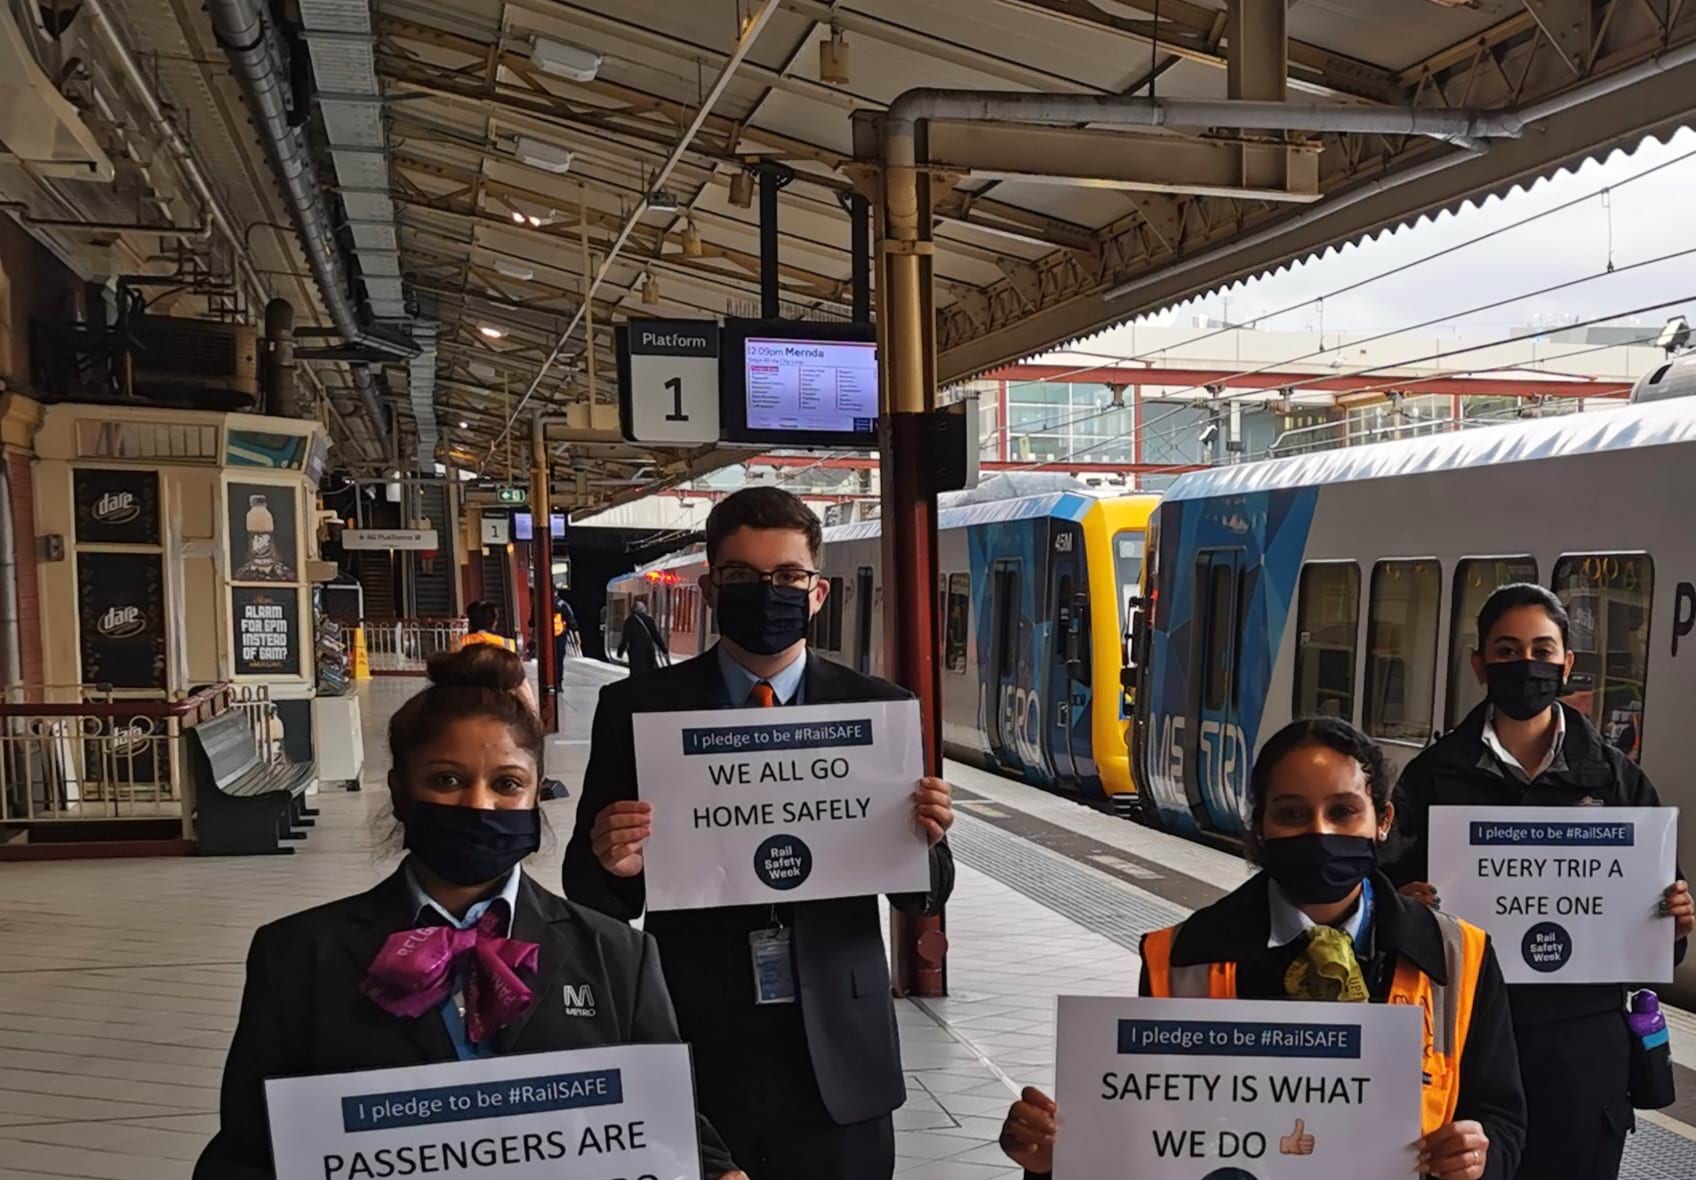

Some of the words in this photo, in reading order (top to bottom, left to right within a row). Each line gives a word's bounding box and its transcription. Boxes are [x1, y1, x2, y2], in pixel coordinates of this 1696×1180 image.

[642, 331, 707, 349] Platform
[785, 347, 824, 358] Mernda
[663, 376, 690, 422] 1
[490, 524, 499, 538] 1
[245, 605, 283, 619] ALARM
[240, 619, 262, 633] FOR
[242, 633, 287, 646] INSTEAD
[242, 647, 257, 660] OF
[693, 733, 698, 747] I
[702, 731, 750, 748] pledge
[754, 731, 769, 744] to
[773, 728, 791, 743] be
[795, 724, 863, 741] #RailSAFE
[708, 763, 751, 786] WE
[760, 760, 804, 783] ALL
[811, 757, 849, 780] GO
[693, 803, 774, 829] HOME
[782, 797, 872, 823] SAFELY
[1486, 826, 1528, 841] pledge
[1531, 828, 1544, 839] to
[1547, 826, 1563, 839] be
[1566, 827, 1626, 840] #RailSAFE
[770, 846, 793, 858] Rail
[764, 856, 802, 870] Safety
[1477, 858, 1547, 879] EVERY
[1553, 858, 1602, 878] TRIP
[1607, 859, 1624, 878] A
[768, 867, 801, 880] Week
[1495, 896, 1549, 915] SAFE
[1556, 896, 1604, 915] ONE
[1536, 932, 1556, 943] Rail
[1530, 941, 1563, 954] Safety
[1532, 951, 1561, 962] Week
[565, 1007, 596, 1017] METRO
[1131, 1028, 1136, 1043] I
[1142, 1026, 1204, 1048] pledge
[1208, 1030, 1228, 1045] to
[1234, 1028, 1256, 1046] be
[1261, 1028, 1348, 1048] #RailSAFE
[1101, 1072, 1221, 1102] SAFETY
[1232, 1074, 1258, 1103] IS
[1268, 1076, 1371, 1105] WHAT
[358, 1102, 365, 1121] I
[372, 1096, 443, 1121] pledge
[449, 1092, 472, 1111] to
[476, 1086, 503, 1109] be
[508, 1077, 608, 1105] #RailSAFE
[577, 1120, 648, 1157] ARE
[1152, 1130, 1206, 1159] WE
[1218, 1130, 1267, 1160] DO
